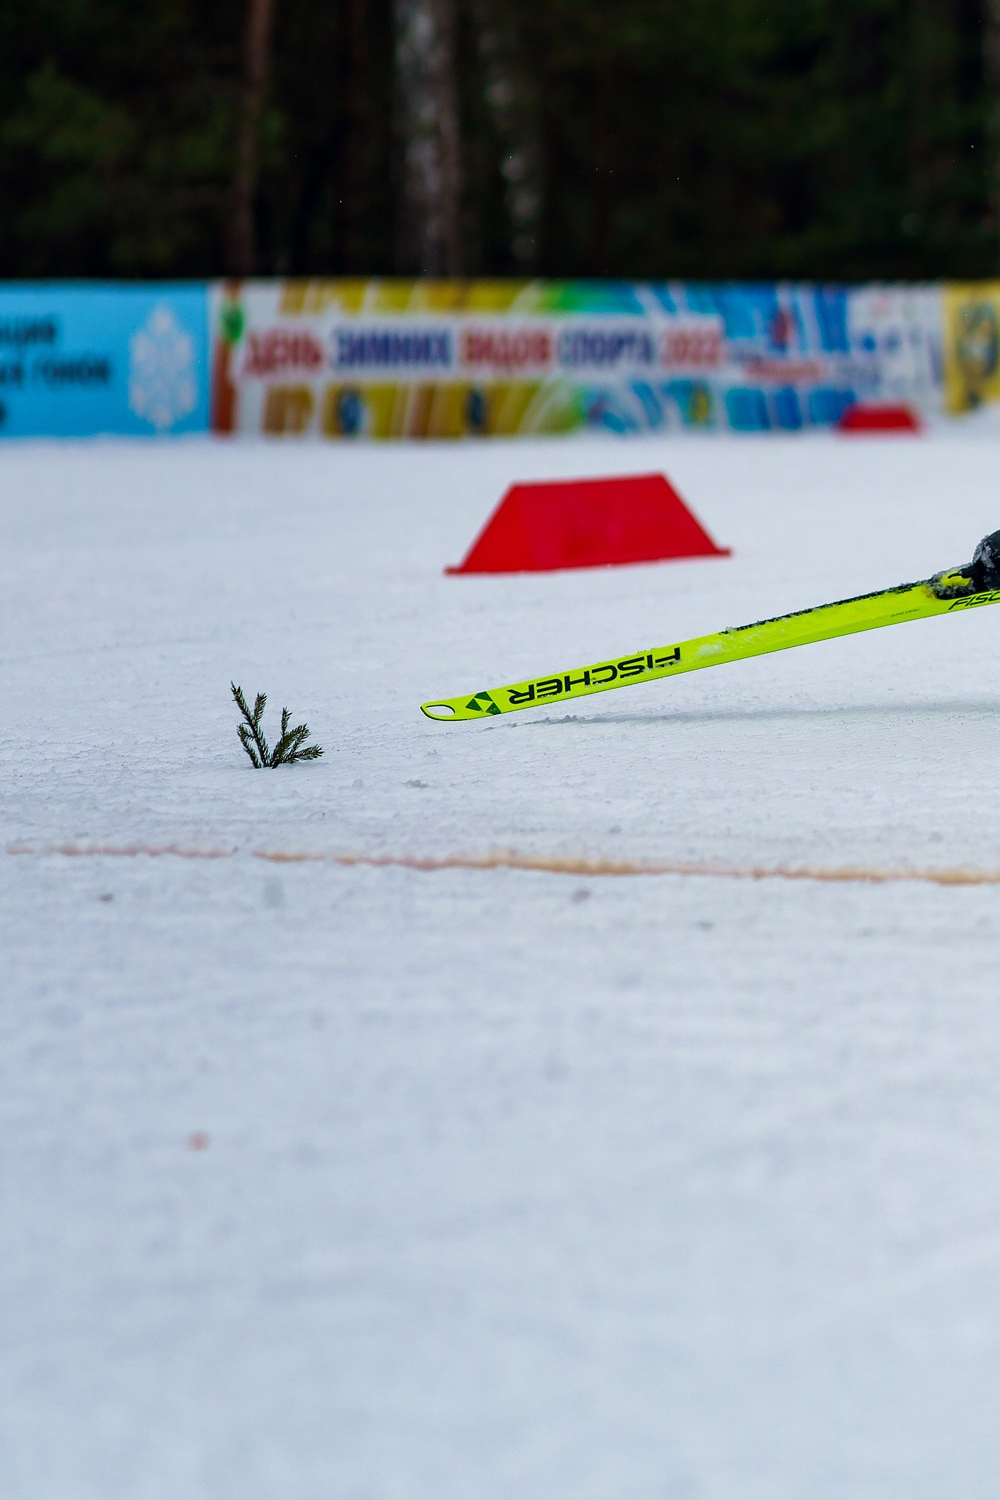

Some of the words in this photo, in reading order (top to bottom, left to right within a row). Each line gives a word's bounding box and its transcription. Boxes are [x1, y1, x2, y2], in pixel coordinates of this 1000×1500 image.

[247, 330, 323, 375] ДЕНЬ
[464, 327, 552, 373] ВИДОВ
[558, 327, 653, 368] СПОРТА
[506, 647, 681, 705] FISCHER
